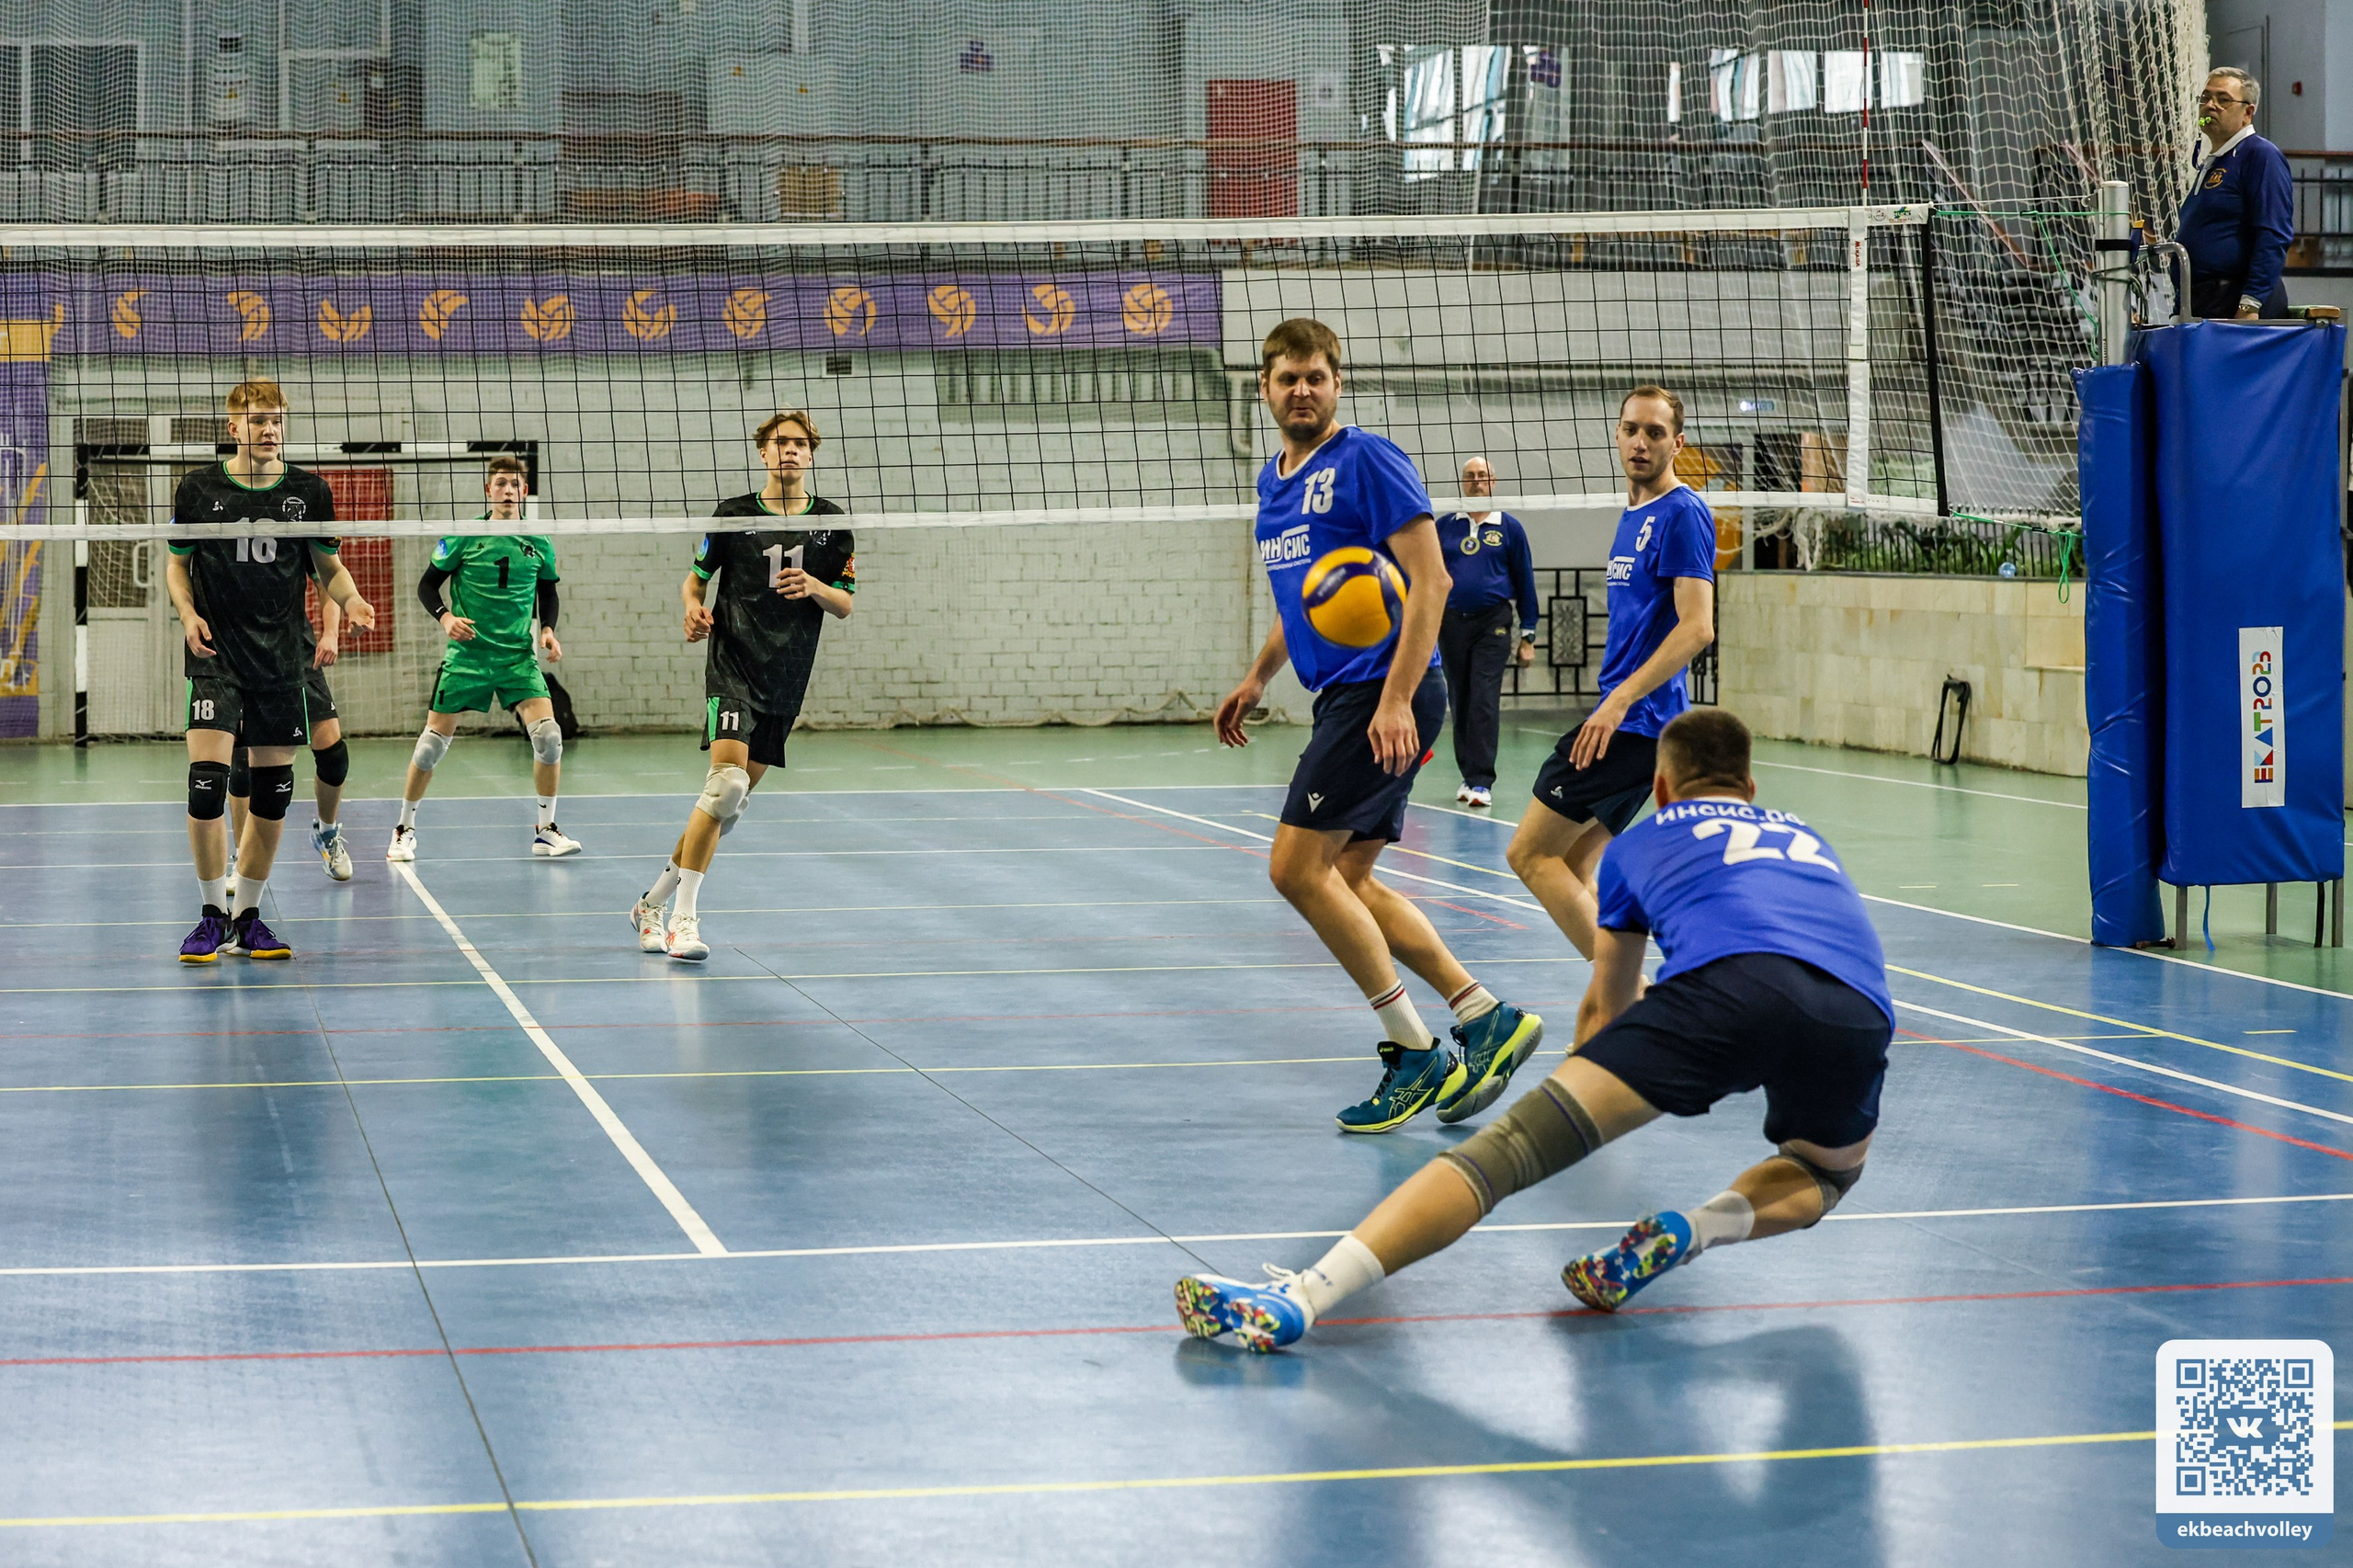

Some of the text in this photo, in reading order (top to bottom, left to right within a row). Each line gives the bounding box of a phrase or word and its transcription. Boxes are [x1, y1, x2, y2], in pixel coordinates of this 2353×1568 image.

[1302, 468, 1336, 515] 13
[236, 517, 278, 563] 18
[1260, 525, 1311, 562] ИНСИС
[1635, 516, 1655, 552] 5
[494, 556, 510, 589] 1
[1607, 556, 1635, 580] НСИС
[192, 699, 215, 721] 18
[438, 689, 445, 705] 1
[720, 710, 739, 732] 11
[2252, 651, 2274, 784] EKAT2023
[1692, 818, 1840, 874] 22
